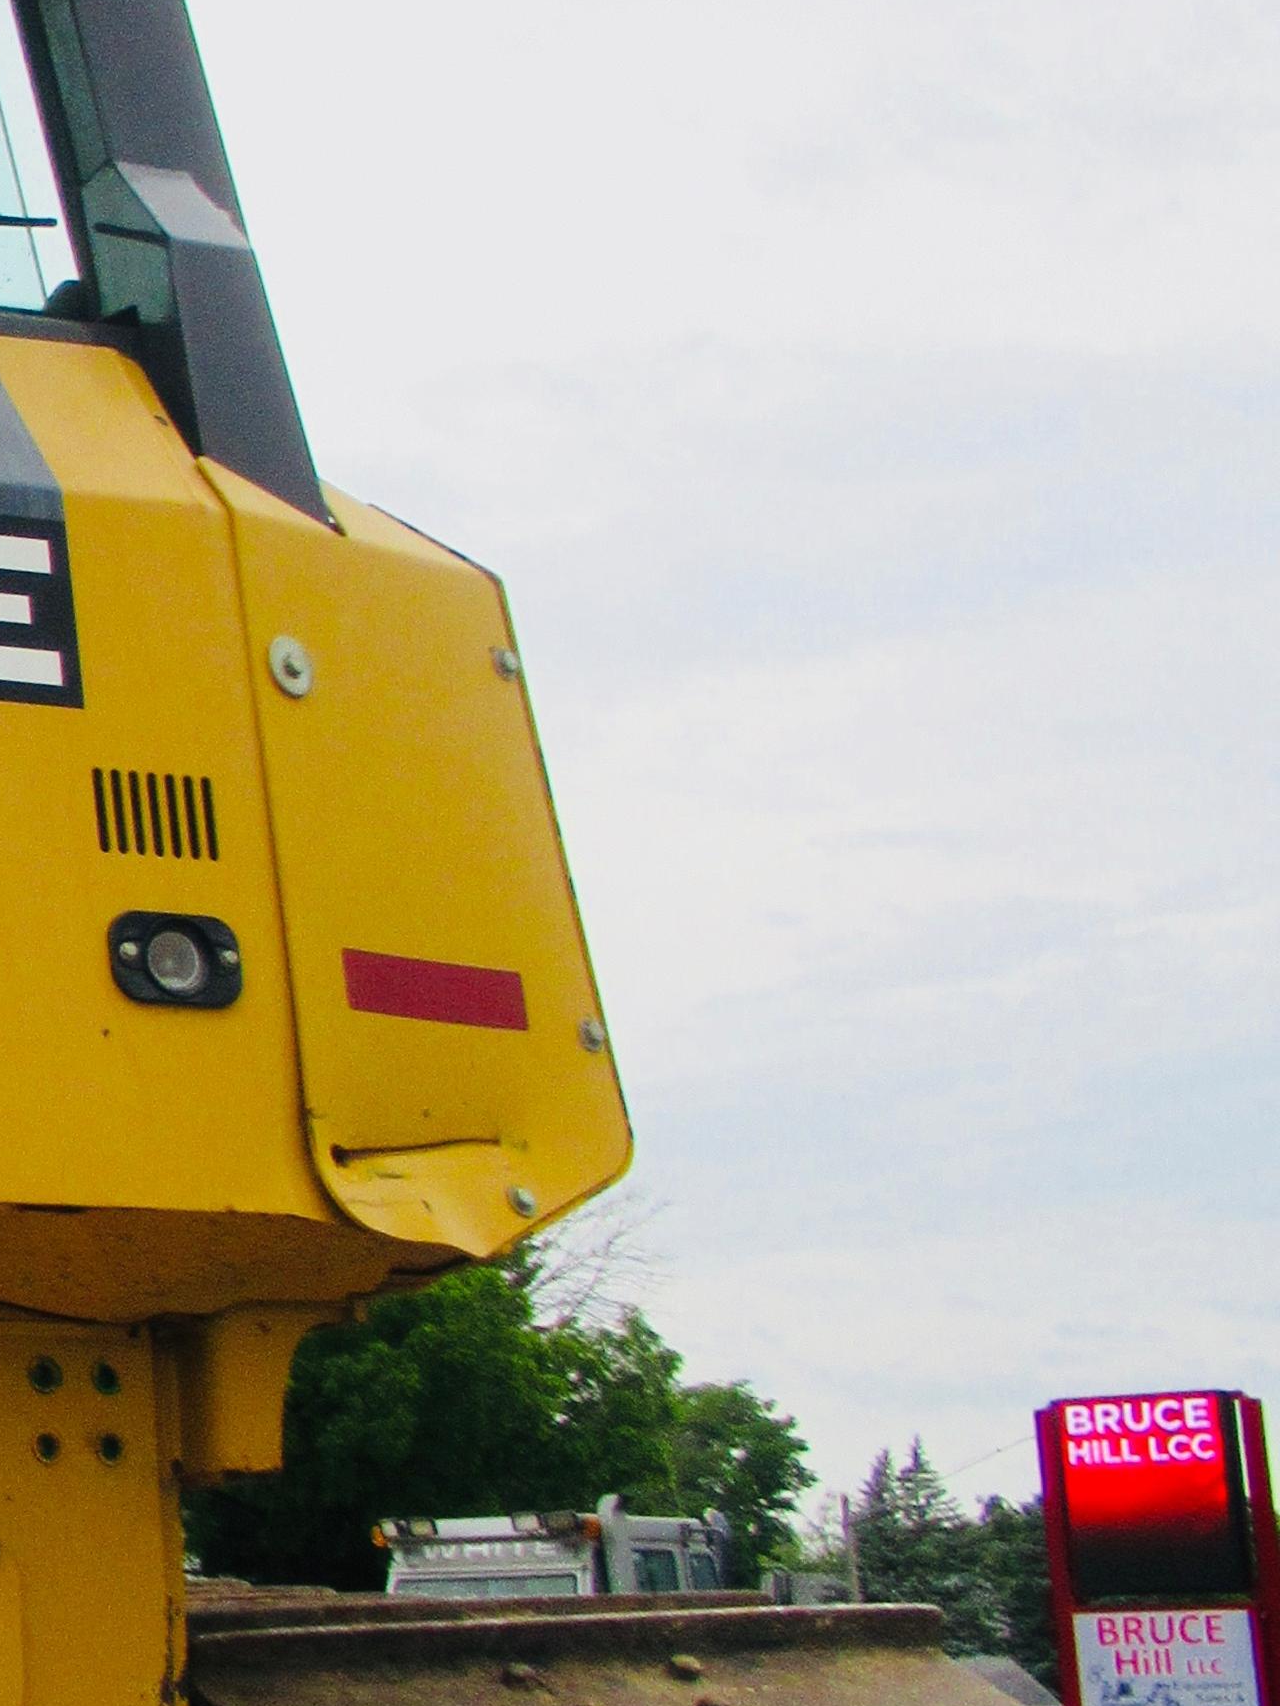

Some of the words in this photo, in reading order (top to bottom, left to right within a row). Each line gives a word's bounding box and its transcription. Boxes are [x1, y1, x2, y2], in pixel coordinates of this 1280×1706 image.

[1066, 1398, 1210, 1435] BRUCE
[1068, 1438, 1141, 1465] HILL
[1148, 1434, 1215, 1461] LCC
[1097, 1615, 1225, 1645] BRUCE
[1115, 1648, 1173, 1675] Hill
[1187, 1658, 1223, 1674] LLC
